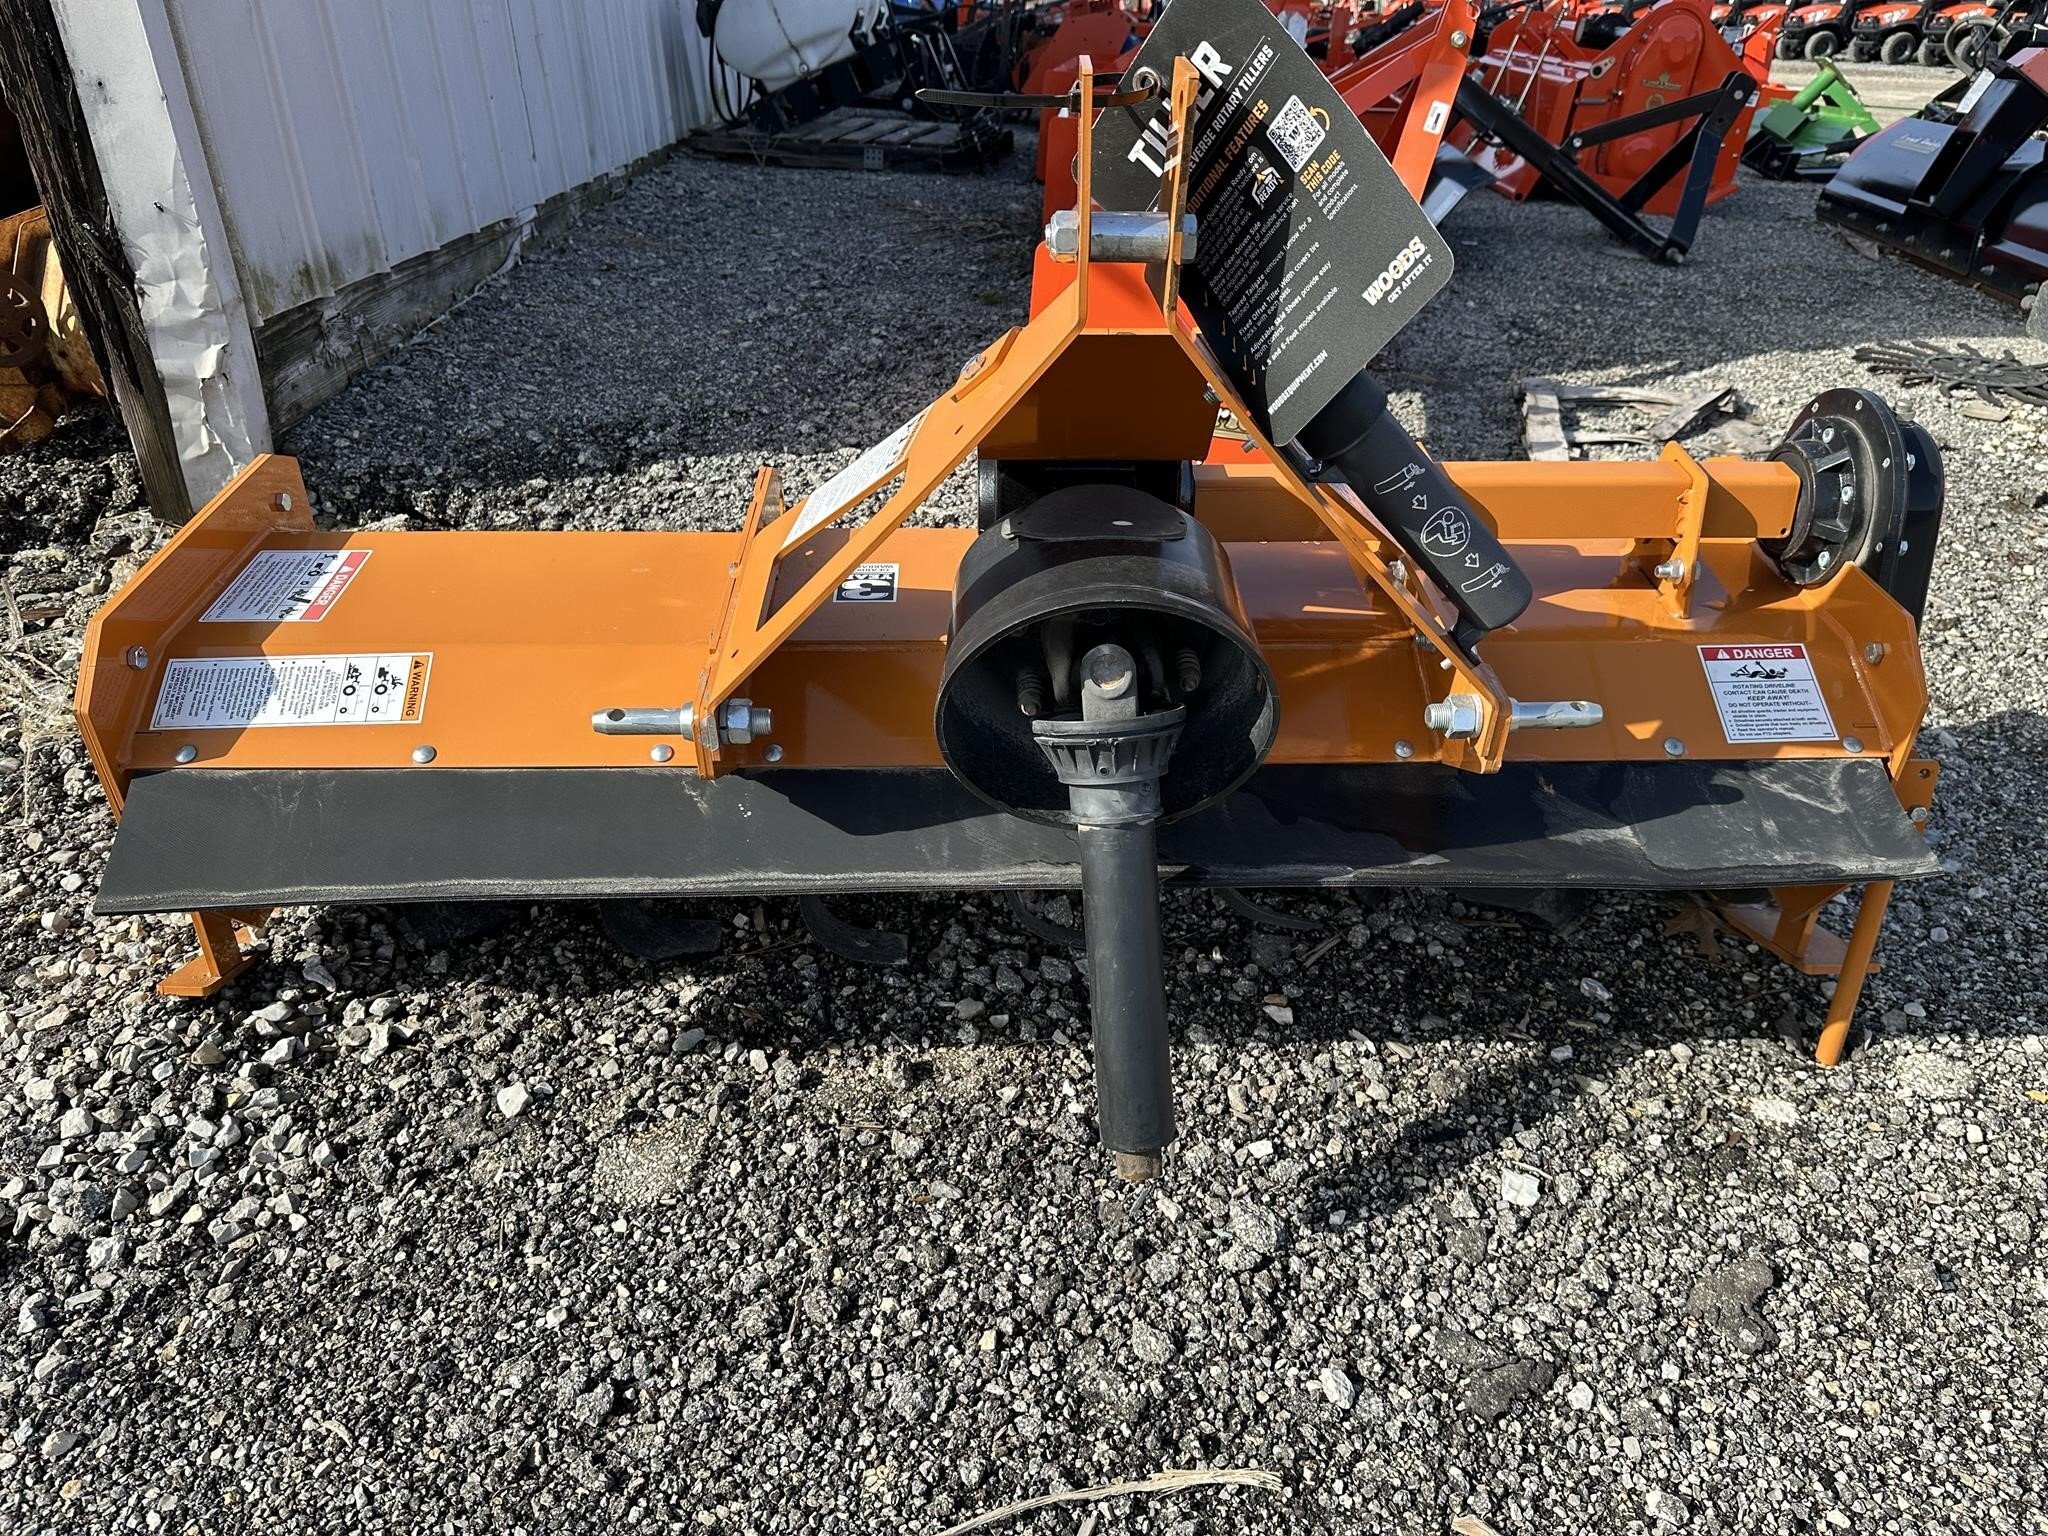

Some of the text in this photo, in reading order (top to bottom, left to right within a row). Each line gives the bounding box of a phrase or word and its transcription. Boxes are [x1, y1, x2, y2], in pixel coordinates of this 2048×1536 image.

[1128, 41, 1233, 177] TILR
[1183, 43, 1274, 174] EVERSE ROTARY TILLERS
[1184, 98, 1271, 216] DDITIONAL FEATURES
[1244, 150, 1257, 168] from
[1298, 159, 1319, 185] SCAN
[1305, 148, 1341, 194] THIS CODE
[1257, 175, 1280, 203] READY
[1311, 159, 1345, 200] For all models
[1316, 168, 1350, 207] and complete
[1274, 190, 1294, 215] service
[1285, 196, 1299, 214] than
[1321, 190, 1341, 214] product
[1249, 219, 1261, 235] Side
[1227, 294, 1247, 318] Tapered
[1245, 271, 1265, 297] Tailgate
[1263, 248, 1284, 274] removes
[1282, 229, 1299, 251] furrow
[1298, 220, 1307, 232] for
[1238, 240, 1319, 335] Fixed Offset Tiller Width covers tire
[1361, 235, 1427, 308] WOODS
[1386, 254, 1433, 304] GET AFTER IT
[1249, 261, 1332, 353] Adjustable Skid Shoes provide easy
[1256, 311, 1268, 326] with
[1266, 298, 1279, 315] each
[1270, 346, 1281, 360] and
[1280, 328, 1299, 349] 6-Foot
[1297, 308, 1317, 331] models
[1314, 284, 1339, 312] available.
[1266, 348, 1329, 415] WOODSEQUIPMENT.COM
[313, 574, 348, 605] DANGER
[1732, 648, 1794, 658] DANGER
[405, 671, 422, 716] WARNING
